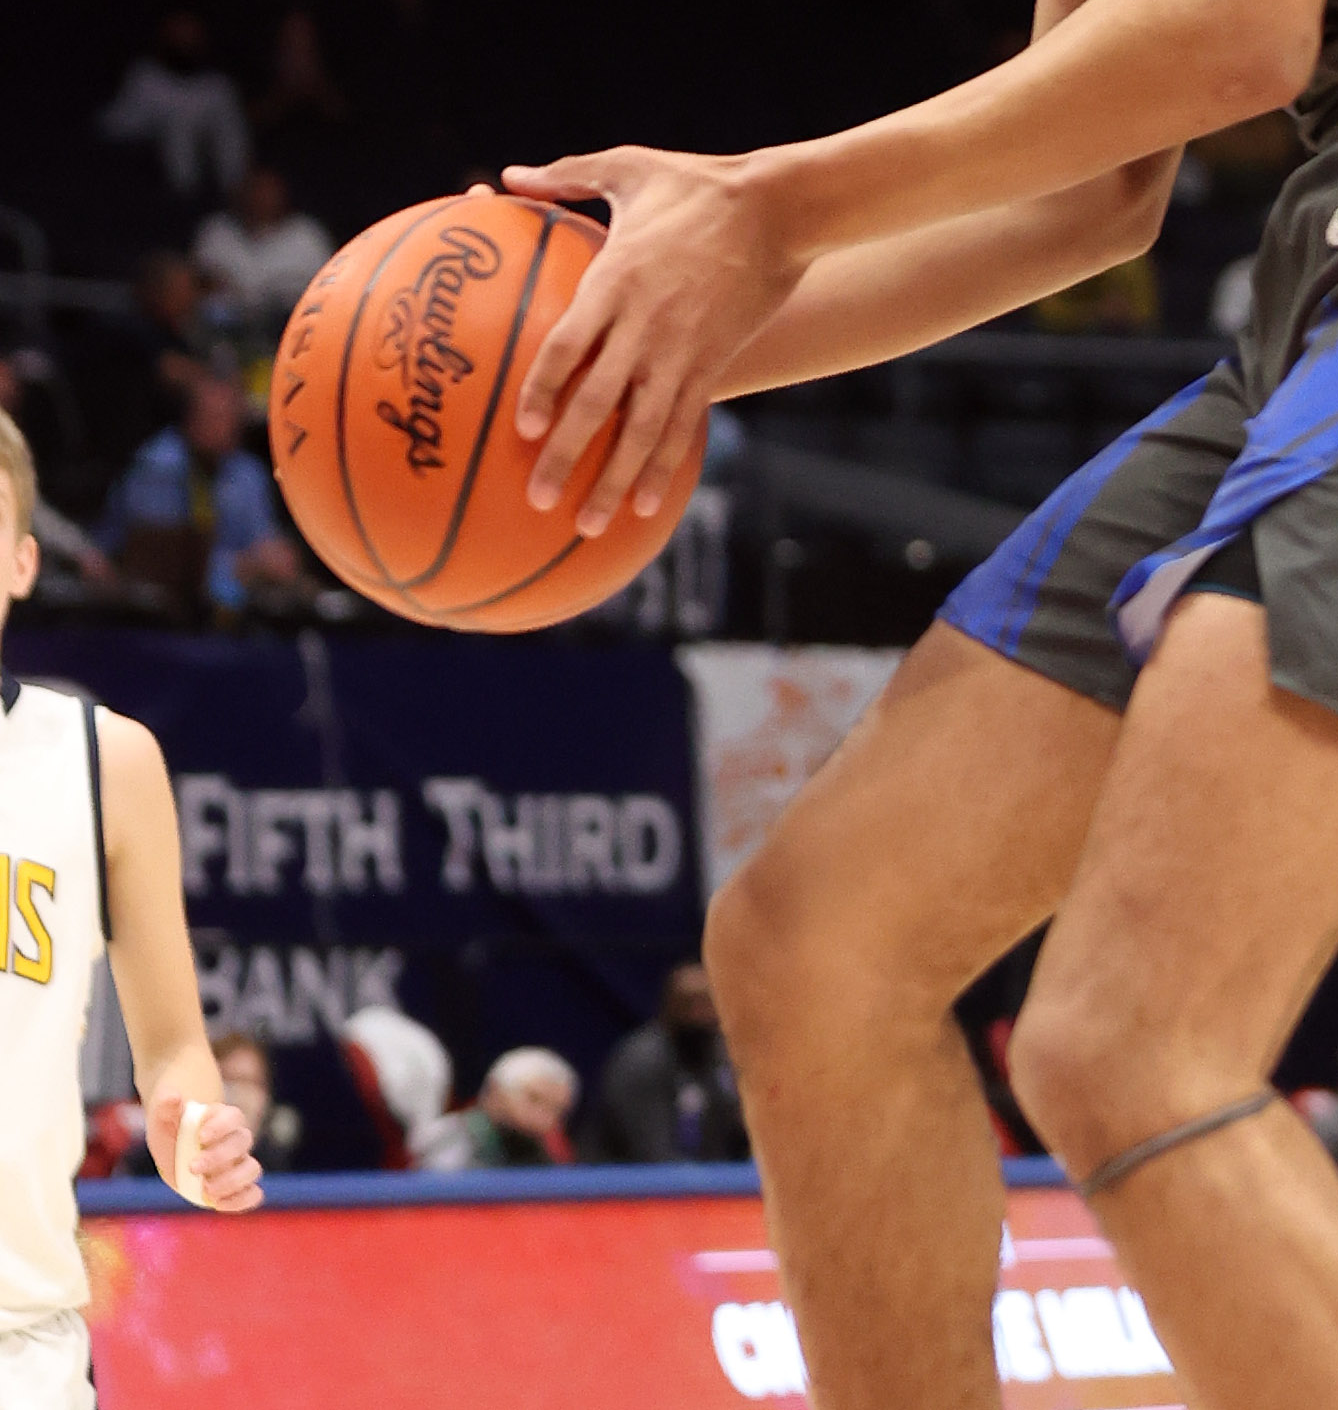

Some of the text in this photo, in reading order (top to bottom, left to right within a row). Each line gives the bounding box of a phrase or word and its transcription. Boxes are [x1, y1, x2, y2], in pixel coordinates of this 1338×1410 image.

[376, 226, 502, 472] Rawlings
[183, 775, 683, 895] FIFTH THIRD
